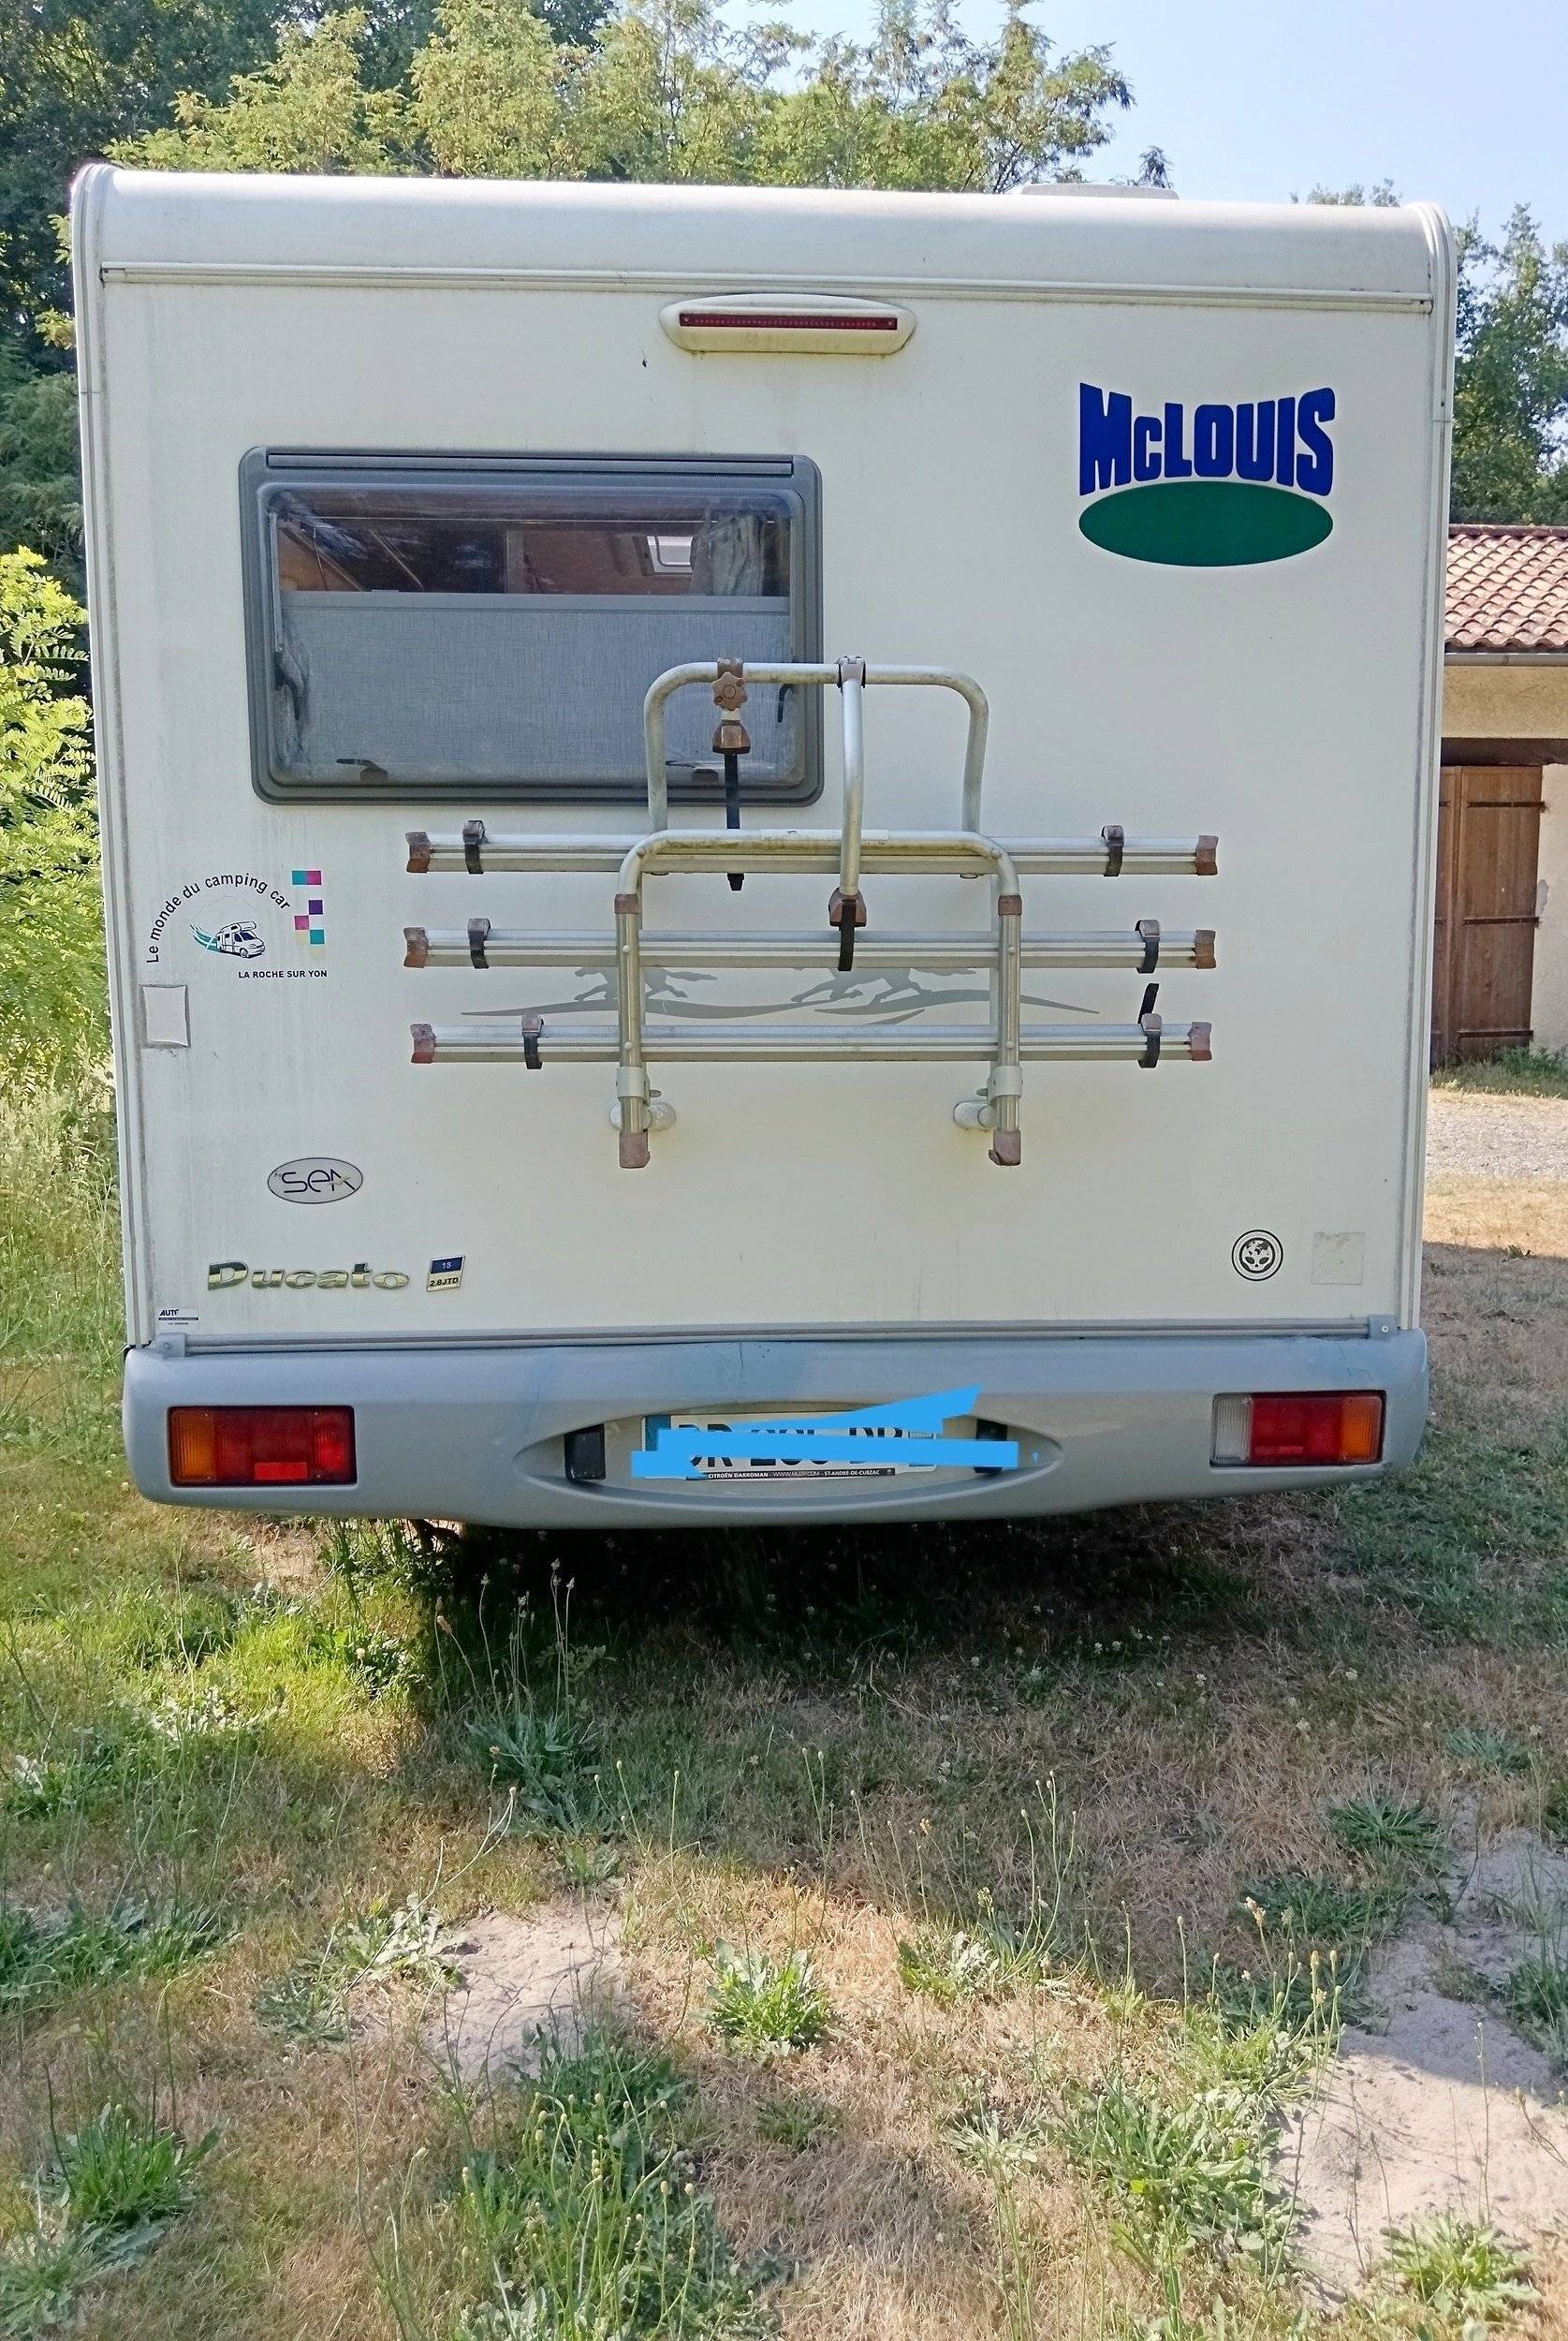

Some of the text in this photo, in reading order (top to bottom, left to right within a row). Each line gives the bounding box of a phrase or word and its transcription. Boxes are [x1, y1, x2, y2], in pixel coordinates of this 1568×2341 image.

[1078, 381, 1336, 497] McLOUIS
[146, 872, 290, 964] Le monde du camping car
[238, 969, 328, 979] LA ROCHE SUR YON
[207, 1260, 410, 1291] Ducato
